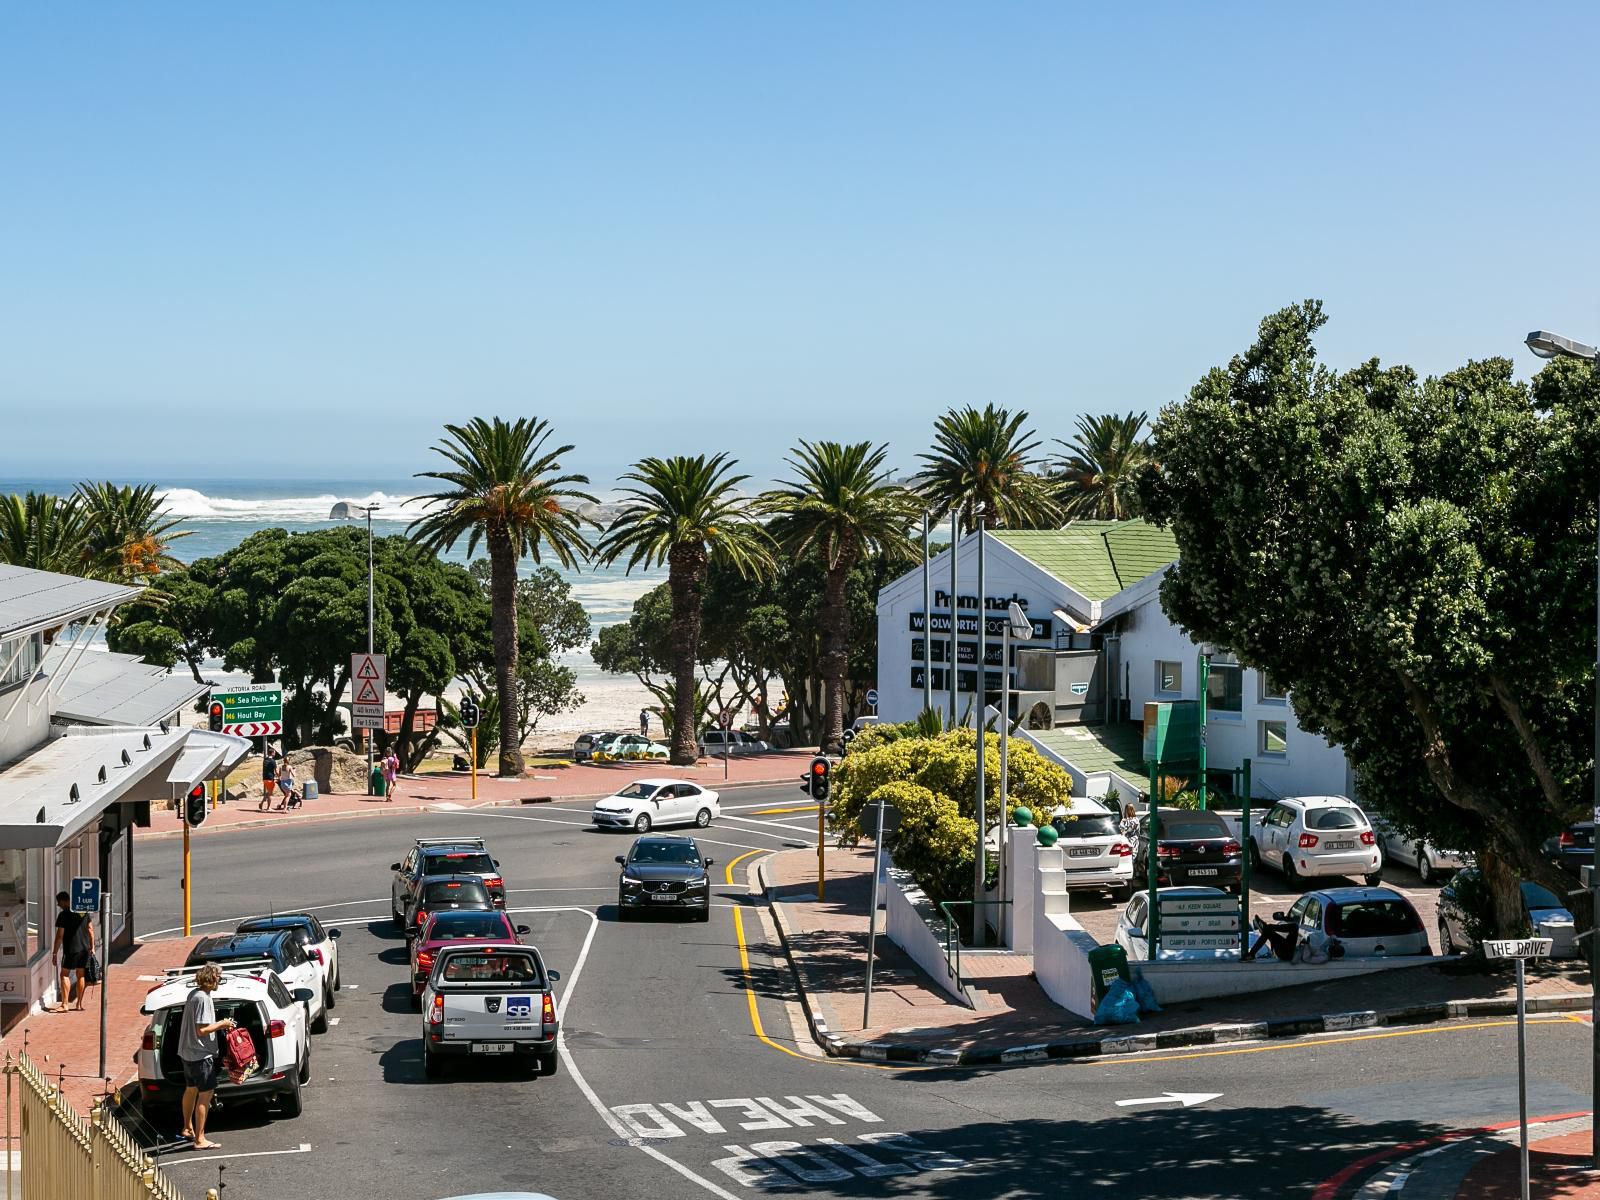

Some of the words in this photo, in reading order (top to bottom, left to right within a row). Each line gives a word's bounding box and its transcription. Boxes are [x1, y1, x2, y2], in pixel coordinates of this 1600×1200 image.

[365, 706, 380, 714] km/h
[82, 881, 92, 894] P
[1489, 942, 1512, 956] THE
[1517, 942, 1546, 955] DRIVE
[508, 1006, 530, 1016] SB
[609, 1093, 885, 1139] AHEAD
[710, 1132, 975, 1189] STOP
